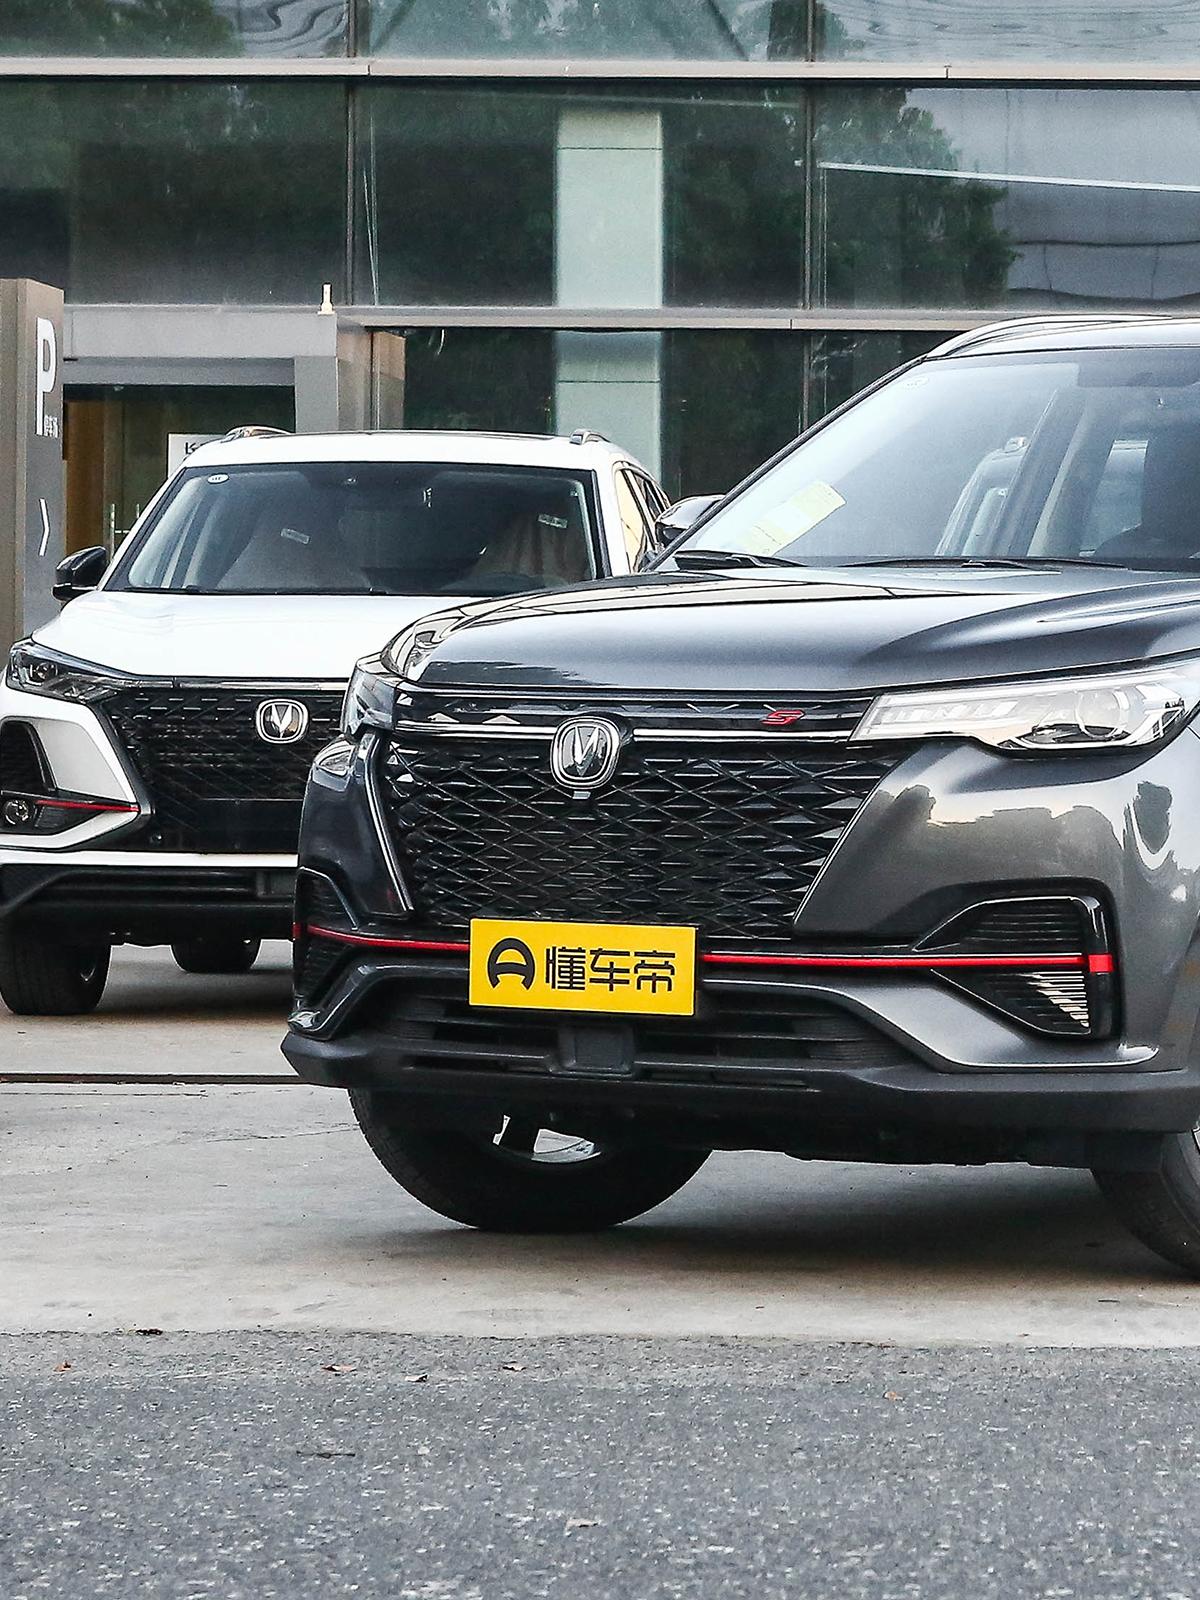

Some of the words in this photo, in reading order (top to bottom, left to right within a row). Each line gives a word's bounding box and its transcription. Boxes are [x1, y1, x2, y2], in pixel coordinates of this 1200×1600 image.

[36, 317, 57, 436] P
[545, 946, 676, 993] 懂车帝
